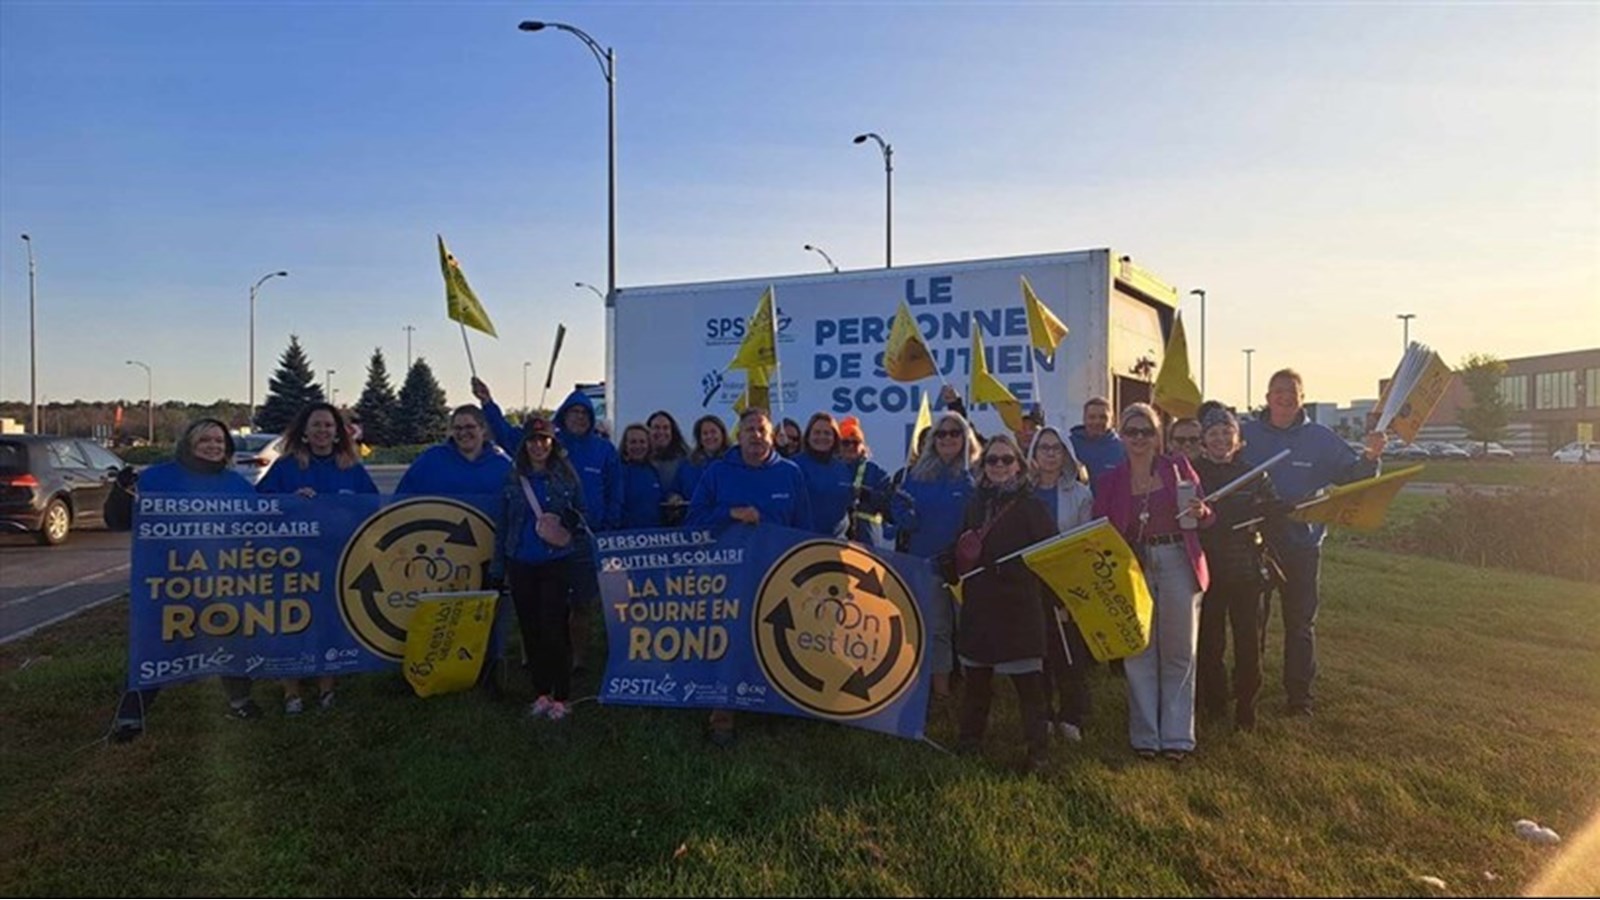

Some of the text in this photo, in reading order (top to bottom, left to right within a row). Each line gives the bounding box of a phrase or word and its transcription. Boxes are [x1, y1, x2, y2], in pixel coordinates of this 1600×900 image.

[906, 276, 952, 305] LE
[814, 353, 862, 379] DE
[140, 498, 280, 513] PERSONNEL DE
[139, 521, 320, 537] SOUTIEN SCOLAIRE
[597, 531, 712, 549] PERSONNEL DE
[168, 541, 301, 571] LA NÉGO
[601, 554, 668, 571] SOUTIEN
[145, 572, 320, 600] TOURNE EN
[627, 569, 727, 598] LA NÉGO
[161, 599, 312, 642] ROND
[614, 599, 740, 623] TOURNE EN
[628, 625, 729, 661] ROND
[797, 631, 879, 662] est là!
